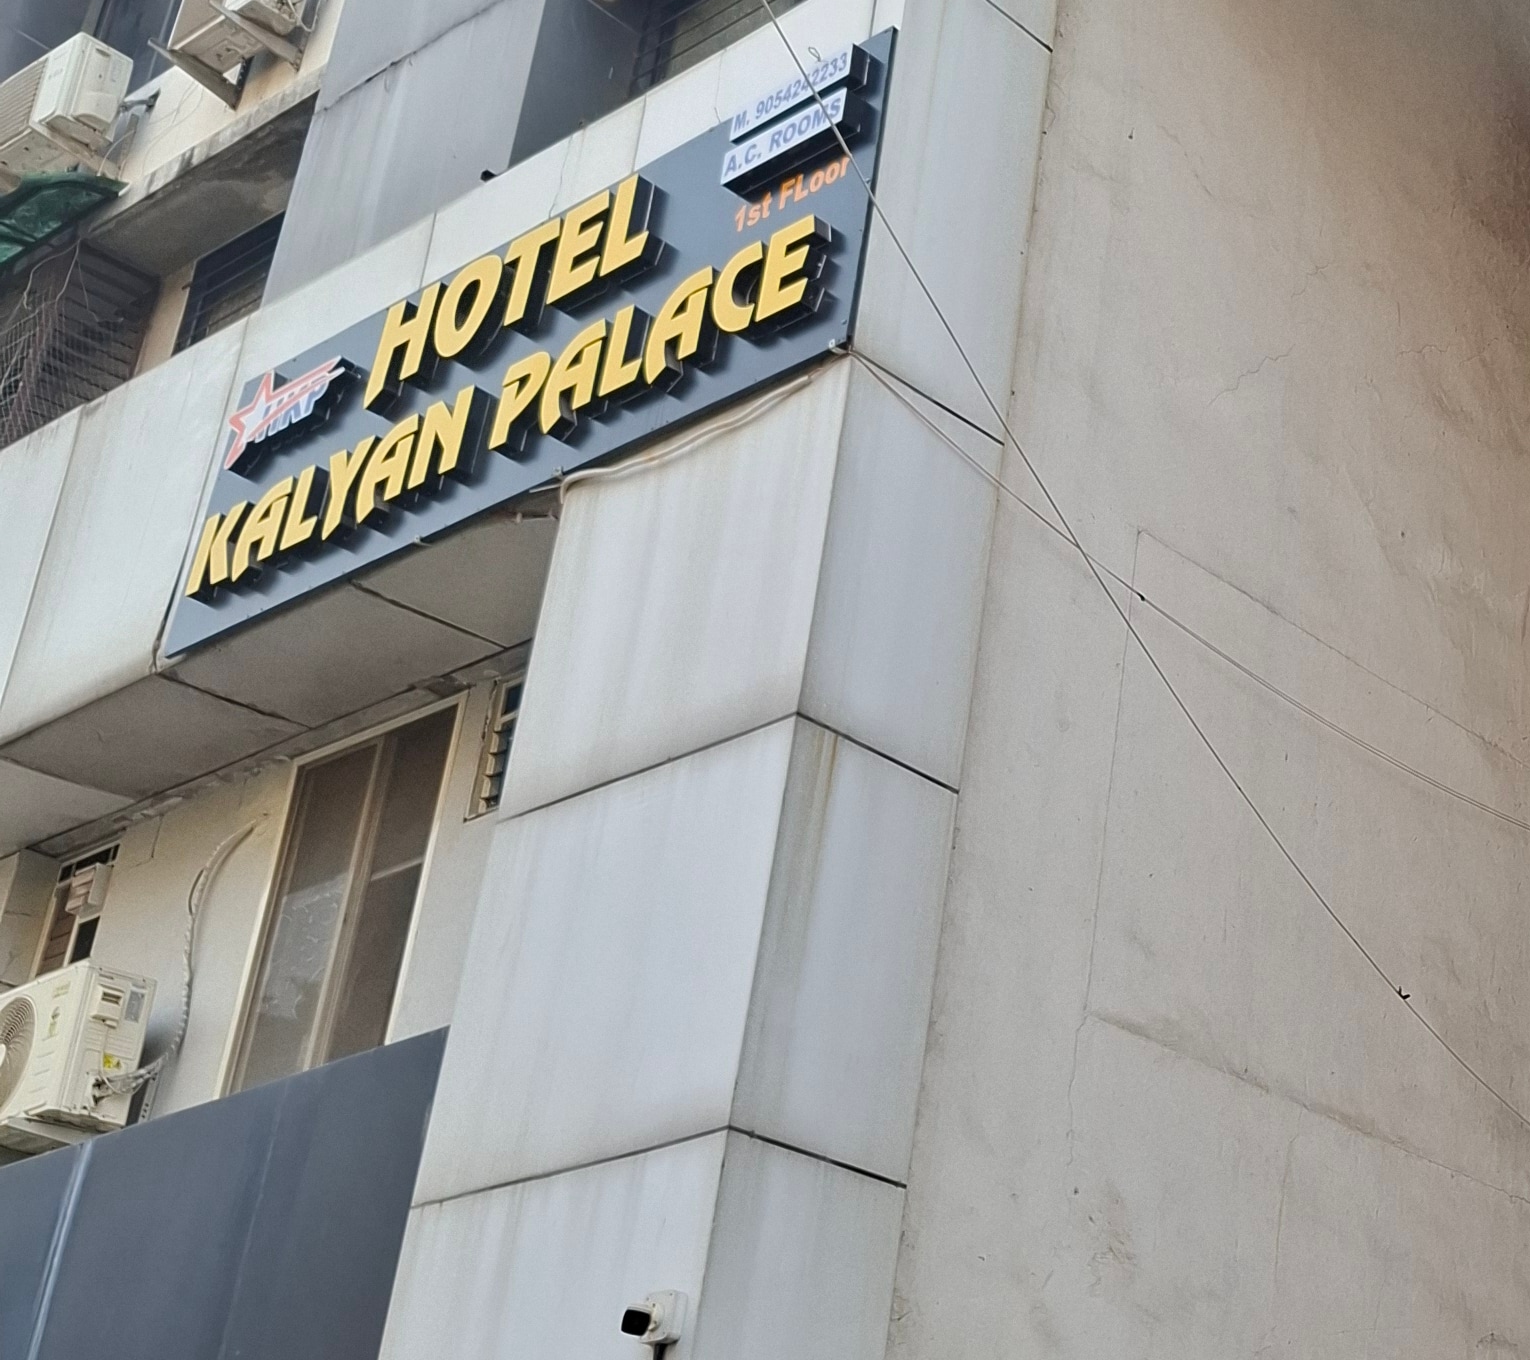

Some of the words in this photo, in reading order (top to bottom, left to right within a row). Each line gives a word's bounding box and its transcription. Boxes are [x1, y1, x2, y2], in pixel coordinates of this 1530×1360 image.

[724, 144, 762, 177] A.C.
[769, 98, 842, 152] ROOMS
[733, 112, 749, 134] M.
[735, 192, 772, 232] 1st
[364, 175, 649, 410] HOTEL
[185, 385, 476, 597] KALYAN
[489, 214, 816, 449] PALACE
